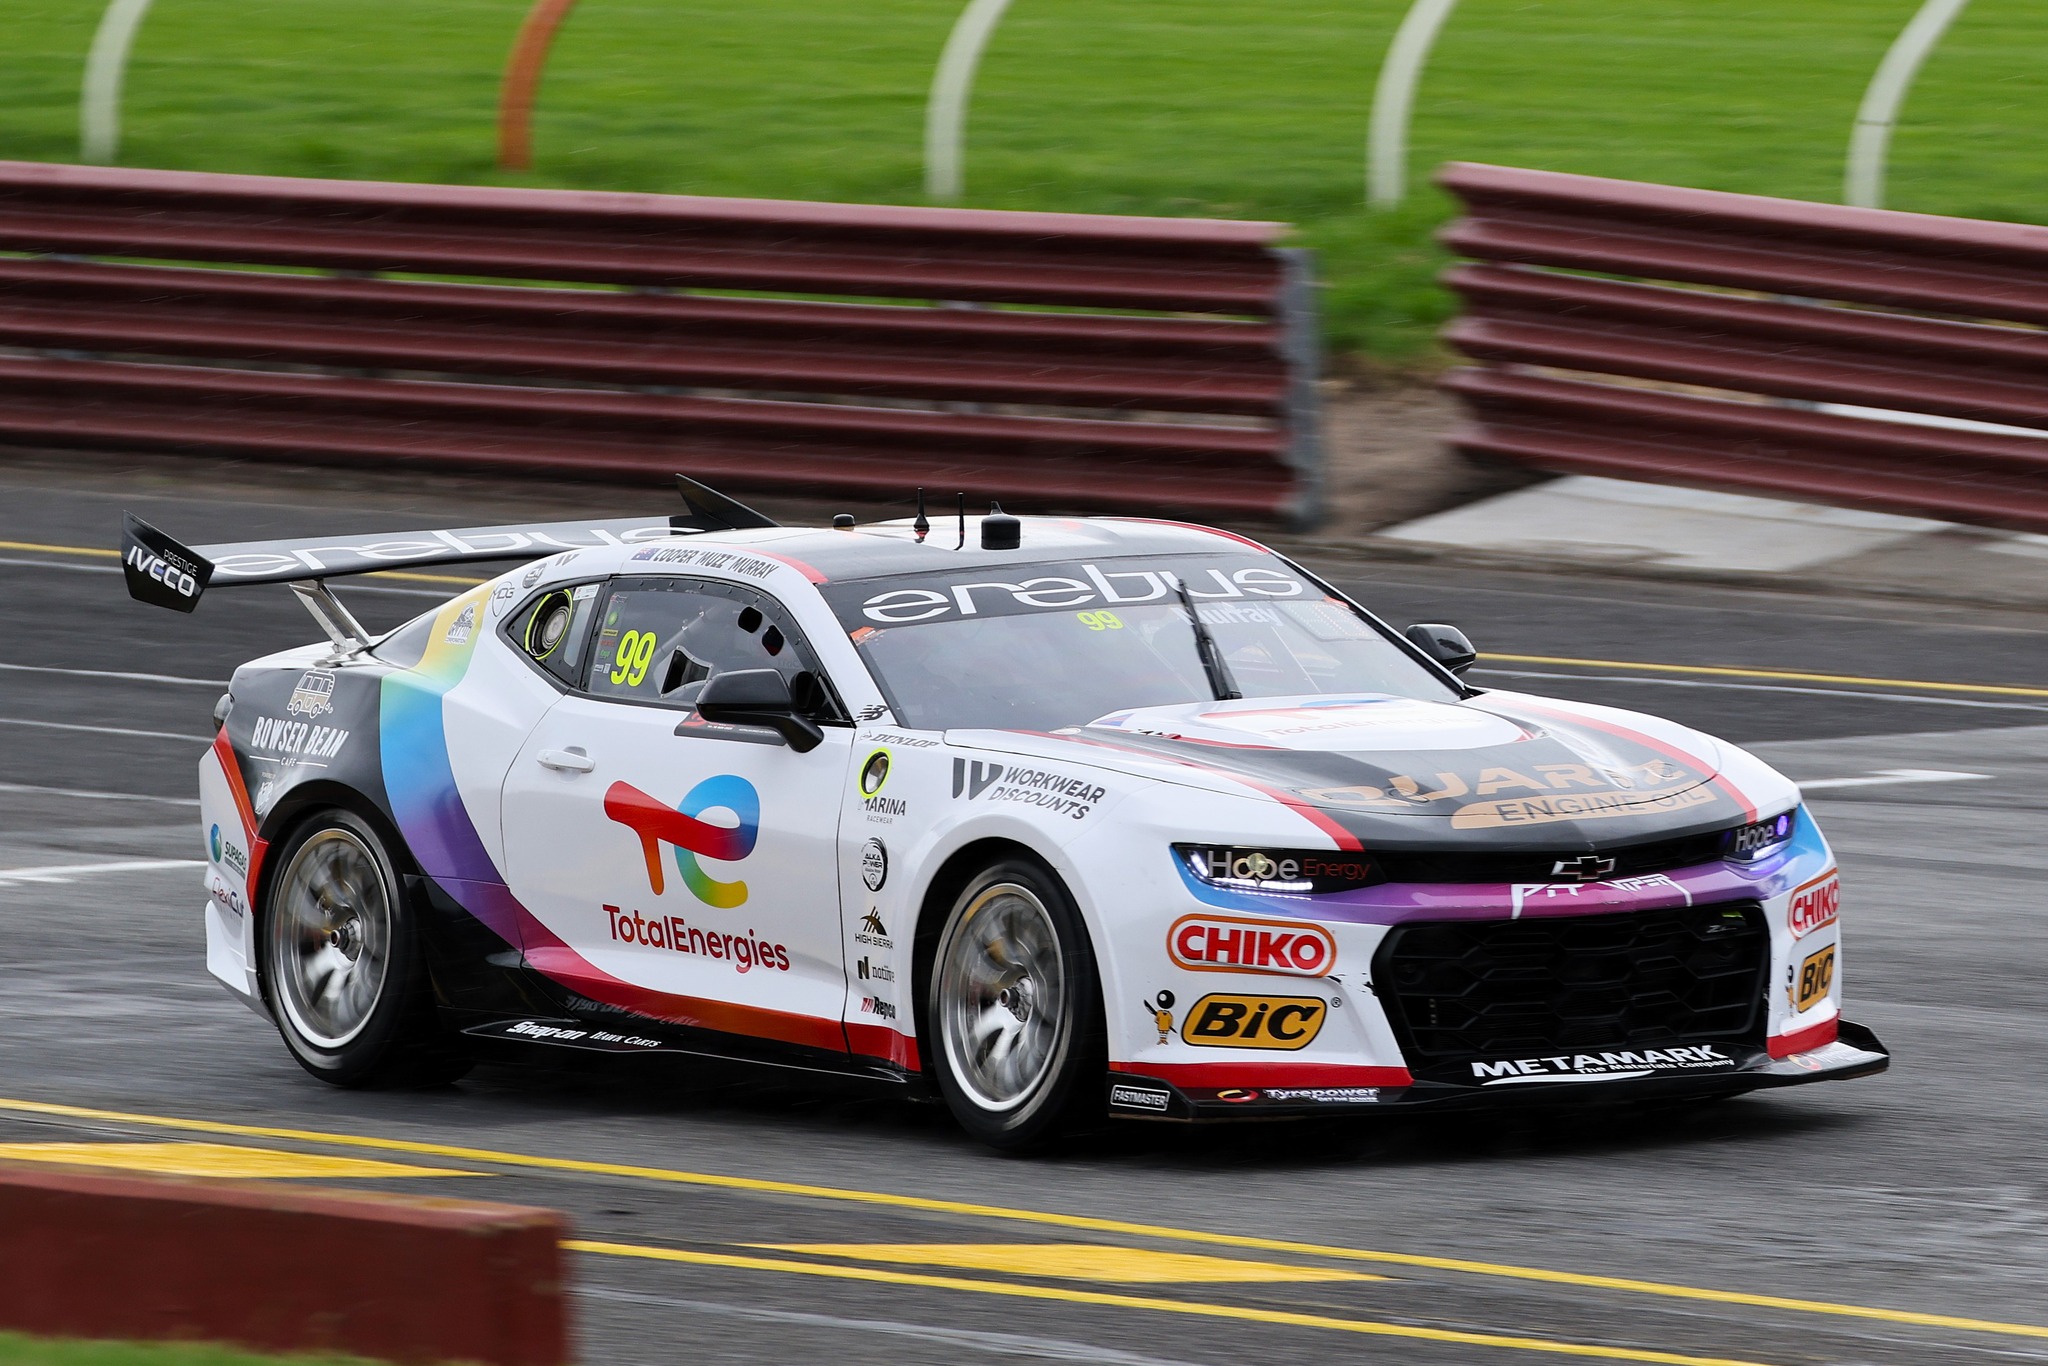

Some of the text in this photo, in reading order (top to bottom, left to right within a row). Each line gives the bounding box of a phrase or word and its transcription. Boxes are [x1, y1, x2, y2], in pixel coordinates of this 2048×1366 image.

[127, 546, 196, 598] IVECO
[163, 549, 198, 577] PRESTIGE
[653, 549, 699, 564] COOPER
[728, 557, 779, 580] MURRAY
[861, 564, 1304, 623] erebus
[1076, 610, 1124, 632] 99
[610, 629, 658, 688] 99
[251, 716, 350, 759] BOWSER BEAN
[870, 733, 940, 748] DUNLOP
[280, 757, 297, 767] CAFE
[1003, 766, 1105, 804] WORKWEAR
[989, 786, 1090, 820] DISCOUNTS
[1495, 788, 1706, 822] ENGINE OIL
[866, 814, 893, 824] RACEWEAR
[1303, 858, 1371, 880] Energy
[603, 904, 790, 974] TotalEnergies
[855, 933, 894, 950] HIGH SIERRA
[1177, 925, 1326, 970] CHIKO
[872, 996, 896, 1020] Repco
[506, 1021, 587, 1041] Snap-on
[1471, 1044, 1730, 1078] METAMARK
[1574, 1057, 1736, 1075] The Materials Company
[1113, 1089, 1168, 1107] FASTMASTER
[1263, 1088, 1380, 1100] Tyrepower
